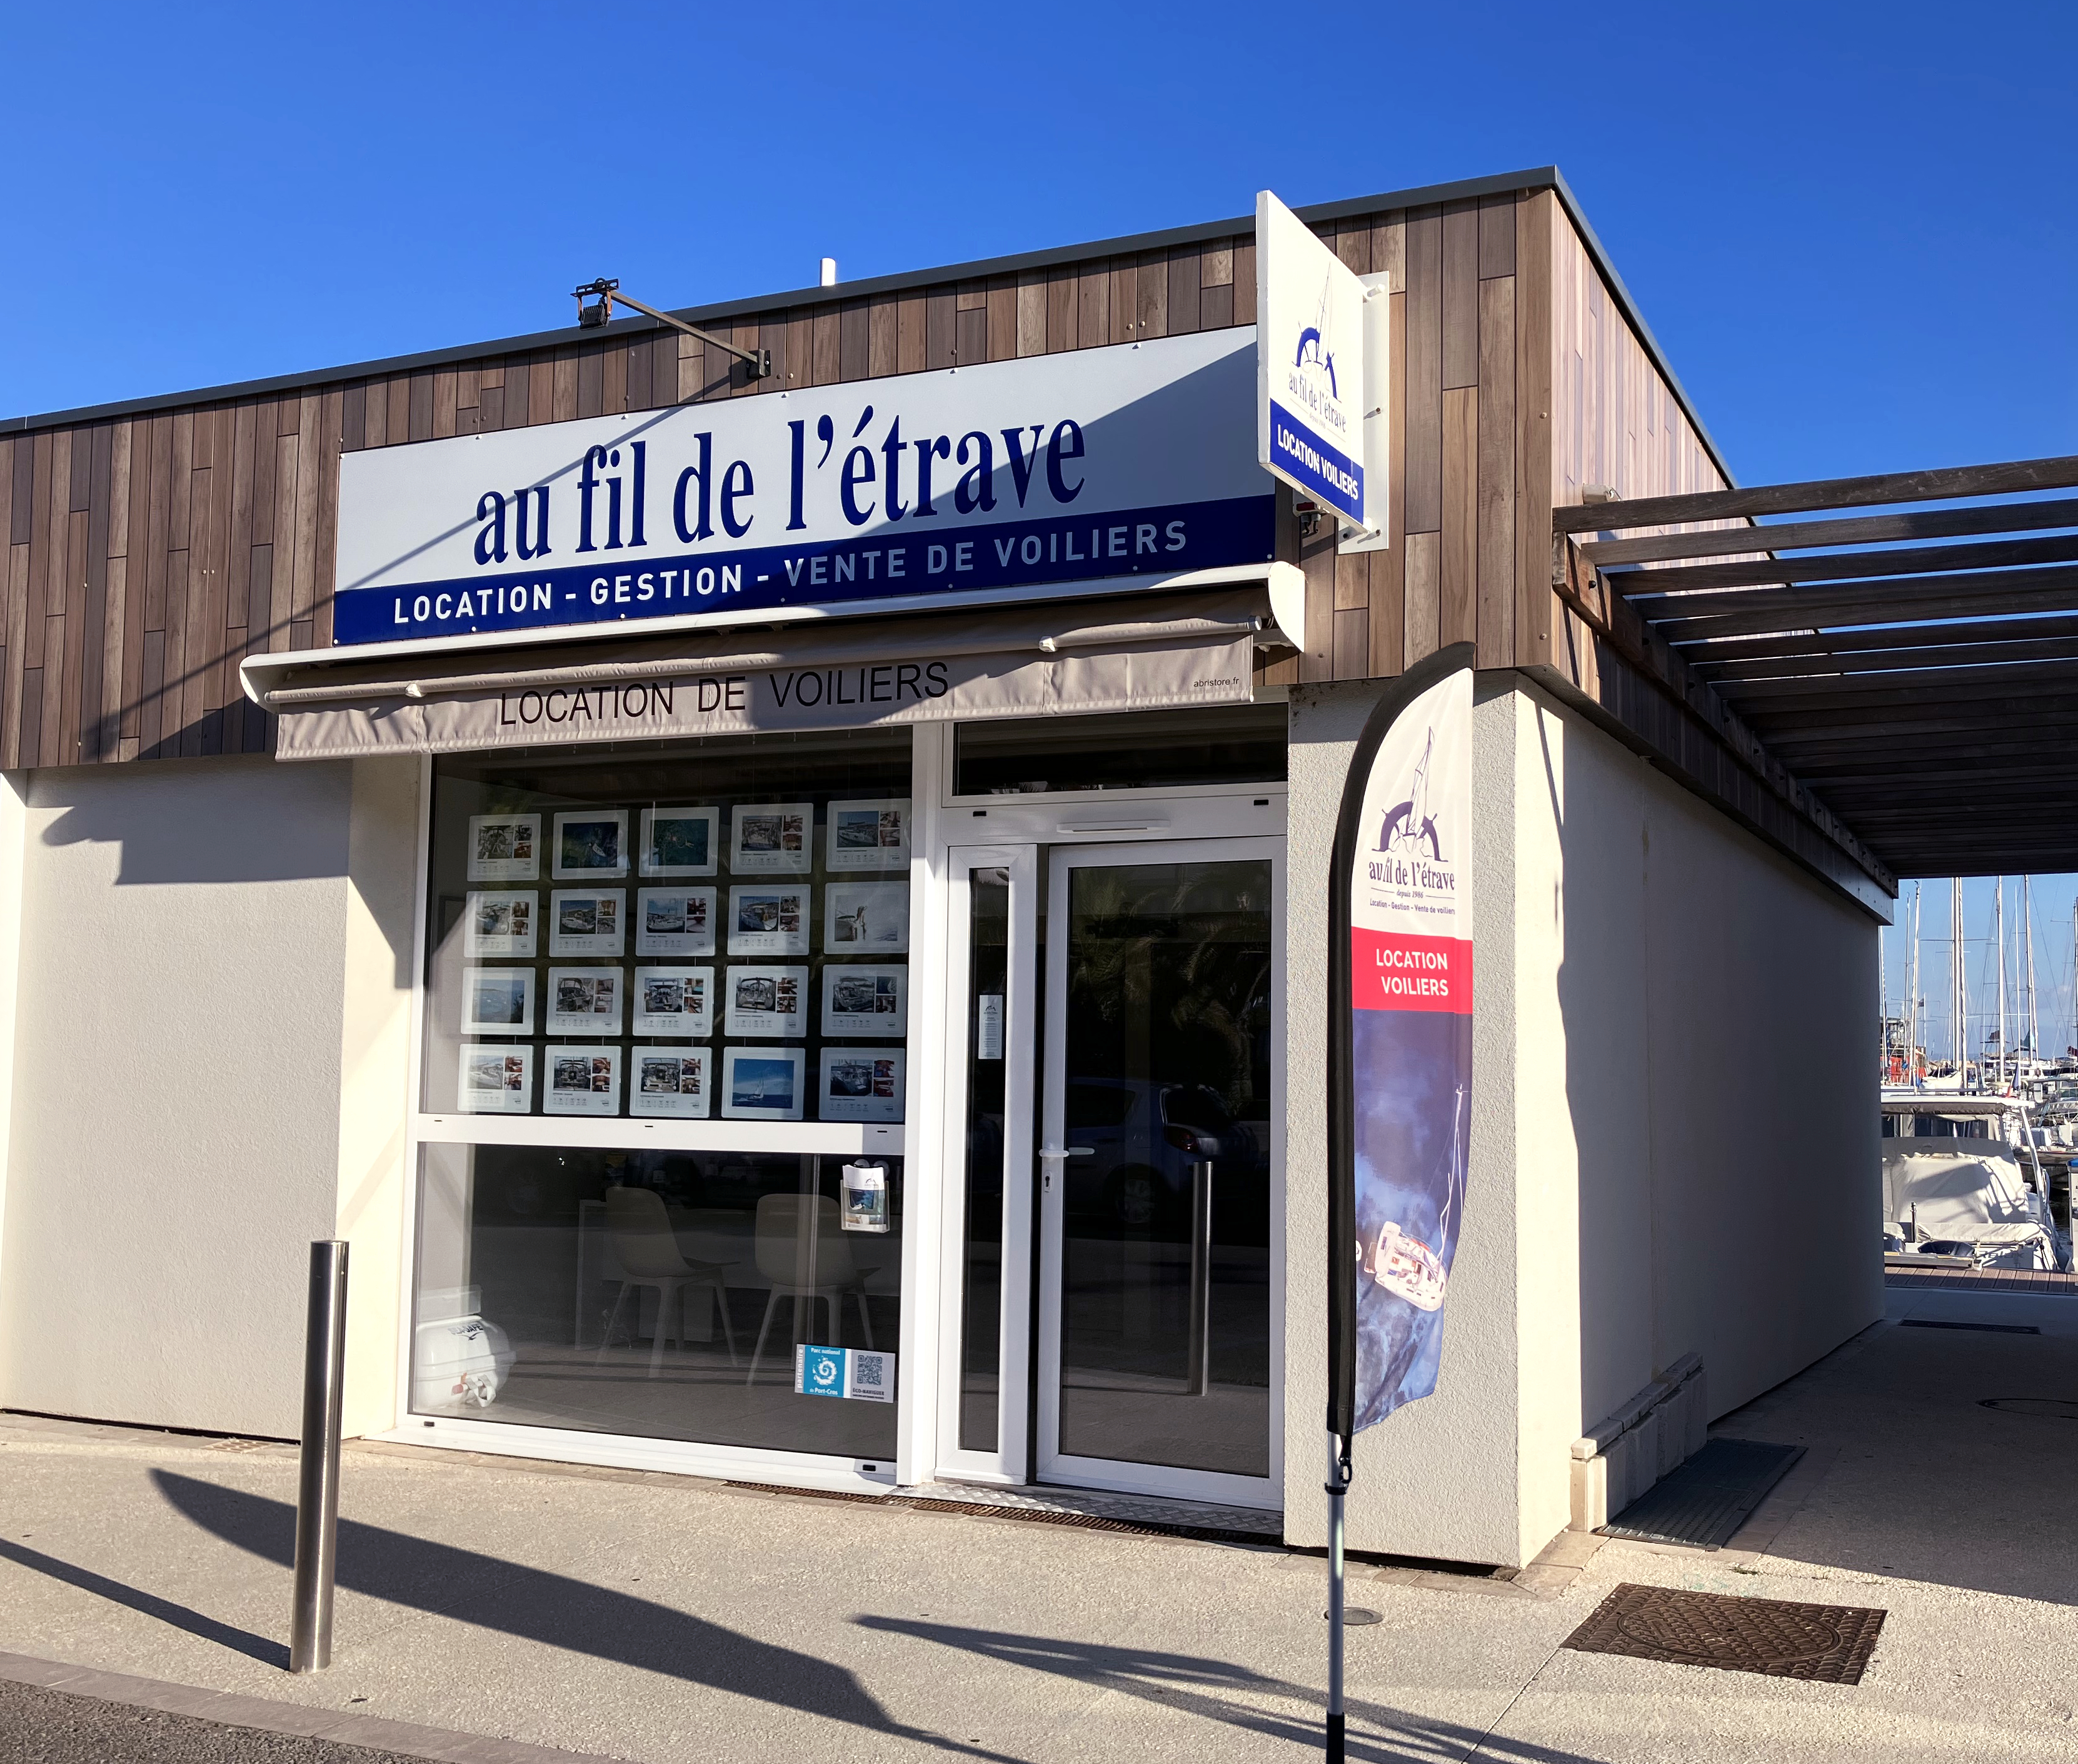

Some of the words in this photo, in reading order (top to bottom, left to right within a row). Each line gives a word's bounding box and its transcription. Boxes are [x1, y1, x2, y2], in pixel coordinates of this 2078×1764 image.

[1289, 373, 1297, 394] au
[1309, 383, 1317, 411] de
[1278, 424, 1320, 474] LOCATION
[1321, 456, 1358, 500] VOILIERS
[474, 486, 551, 565] au
[575, 441, 648, 553] fil
[673, 432, 754, 544] de
[786, 405, 1085, 531] l'étrave
[394, 583, 551, 624] LOCATION
[590, 564, 741, 604] GESTION
[784, 548, 906, 586] VENTE
[928, 542, 974, 574] DE
[995, 521, 1187, 568] VOILIERS
[500, 681, 673, 726] LOCATION
[698, 676, 746, 711] DE
[769, 661, 949, 708] VOILIERS
[1193, 677, 1239, 687] abristore.fr
[1369, 861, 1382, 881] au
[1395, 860, 1408, 885] de
[1411, 861, 1455, 890] l'étrave
[1370, 898, 1387, 908] Location
[1391, 901, 1410, 911] Gestion
[1414, 904, 1428, 913] Vente
[1397, 890, 1410, 898] depuis
[1377, 948, 1448, 970] LOCATION
[1381, 976, 1448, 996] VOILIERS
[815, 1387, 838, 1395] Port-Cros
